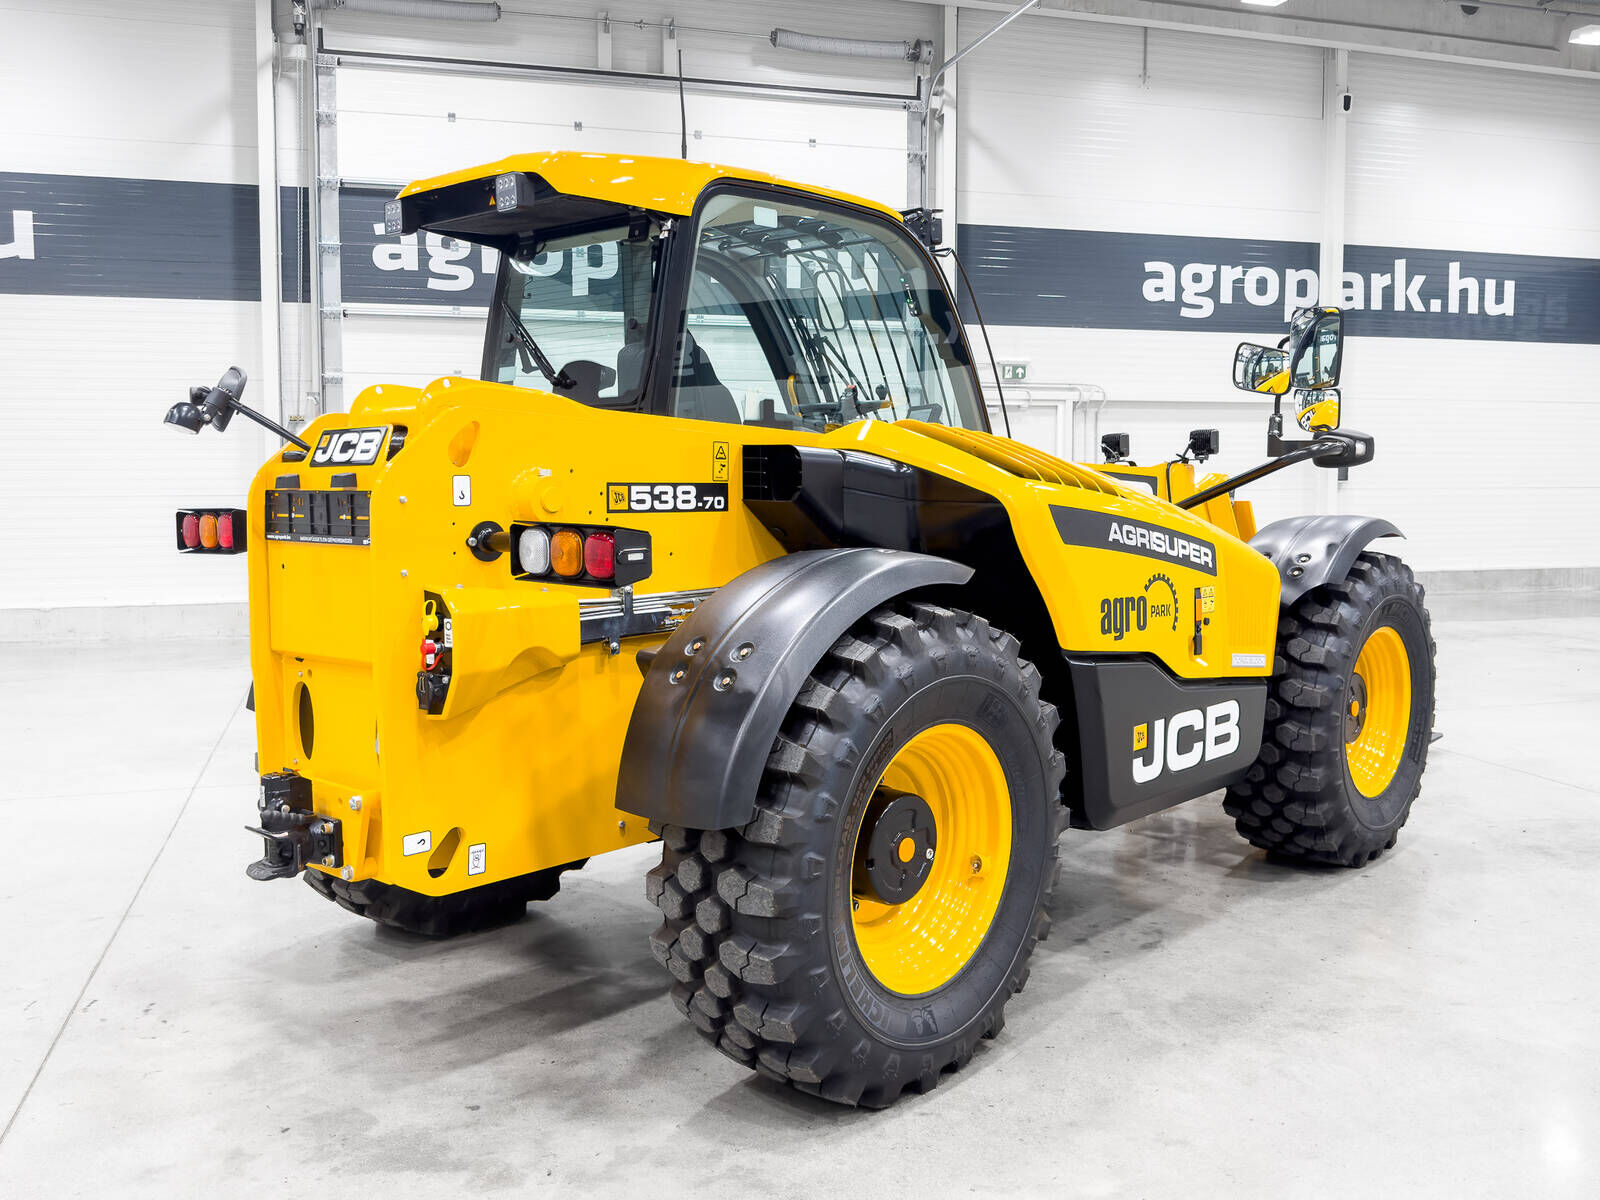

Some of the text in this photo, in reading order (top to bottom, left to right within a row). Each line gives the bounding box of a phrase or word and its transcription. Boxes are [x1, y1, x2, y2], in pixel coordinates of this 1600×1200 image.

[1142, 258, 1516, 322] agropark.hu
[313, 431, 382, 463] JCB
[1100, 595, 1171, 641] agro PARK
[1132, 700, 1240, 784] JCB
